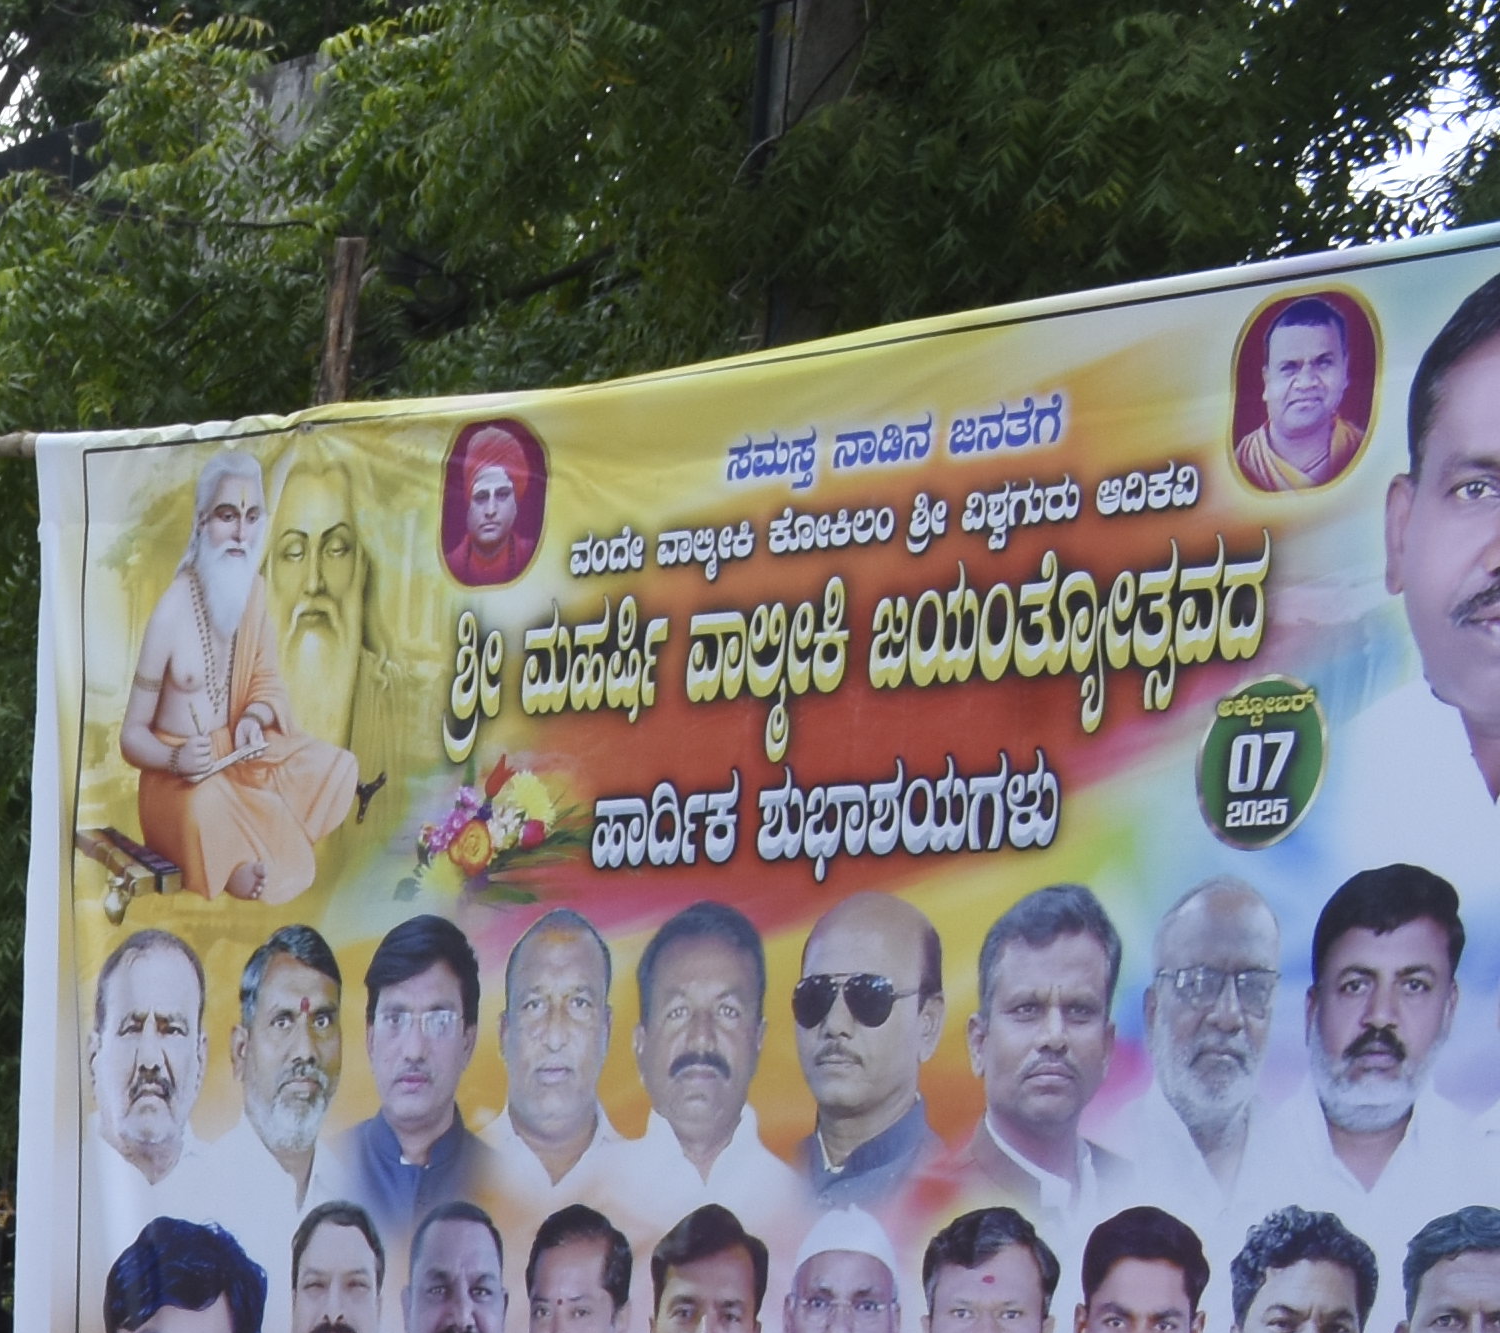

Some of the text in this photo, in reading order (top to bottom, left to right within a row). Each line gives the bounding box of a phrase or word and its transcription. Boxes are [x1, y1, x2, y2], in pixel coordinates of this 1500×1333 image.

[726, 393, 1063, 490] ಸಮಸ್ತ ನಾಡಿನ ಜನತೆಗೆ
[569, 460, 1200, 582] ವಂದೇ ವಾಲ್ಮೀಕಿ ಕೋಕಿಲಂ ಶ್ರೀ ವಿಶ್ವಗುರು ಆದಿಕವಿ
[442, 527, 1273, 764] ಶ್ರೀ ಮಹರ್ಷಿ ವಾಲ್ಮೀಕಿ ಜಯಂತ್ಯೋತ್ಸವದ
[1216, 687, 1317, 728] ಅಕ್ಟೋಬರ್
[1227, 730, 1297, 794] 07
[591, 748, 1061, 883] ಹಾರ್ದಿಕ ಶುಭಾಶಯಗಳು
[1224, 798, 1289, 829] 2025
